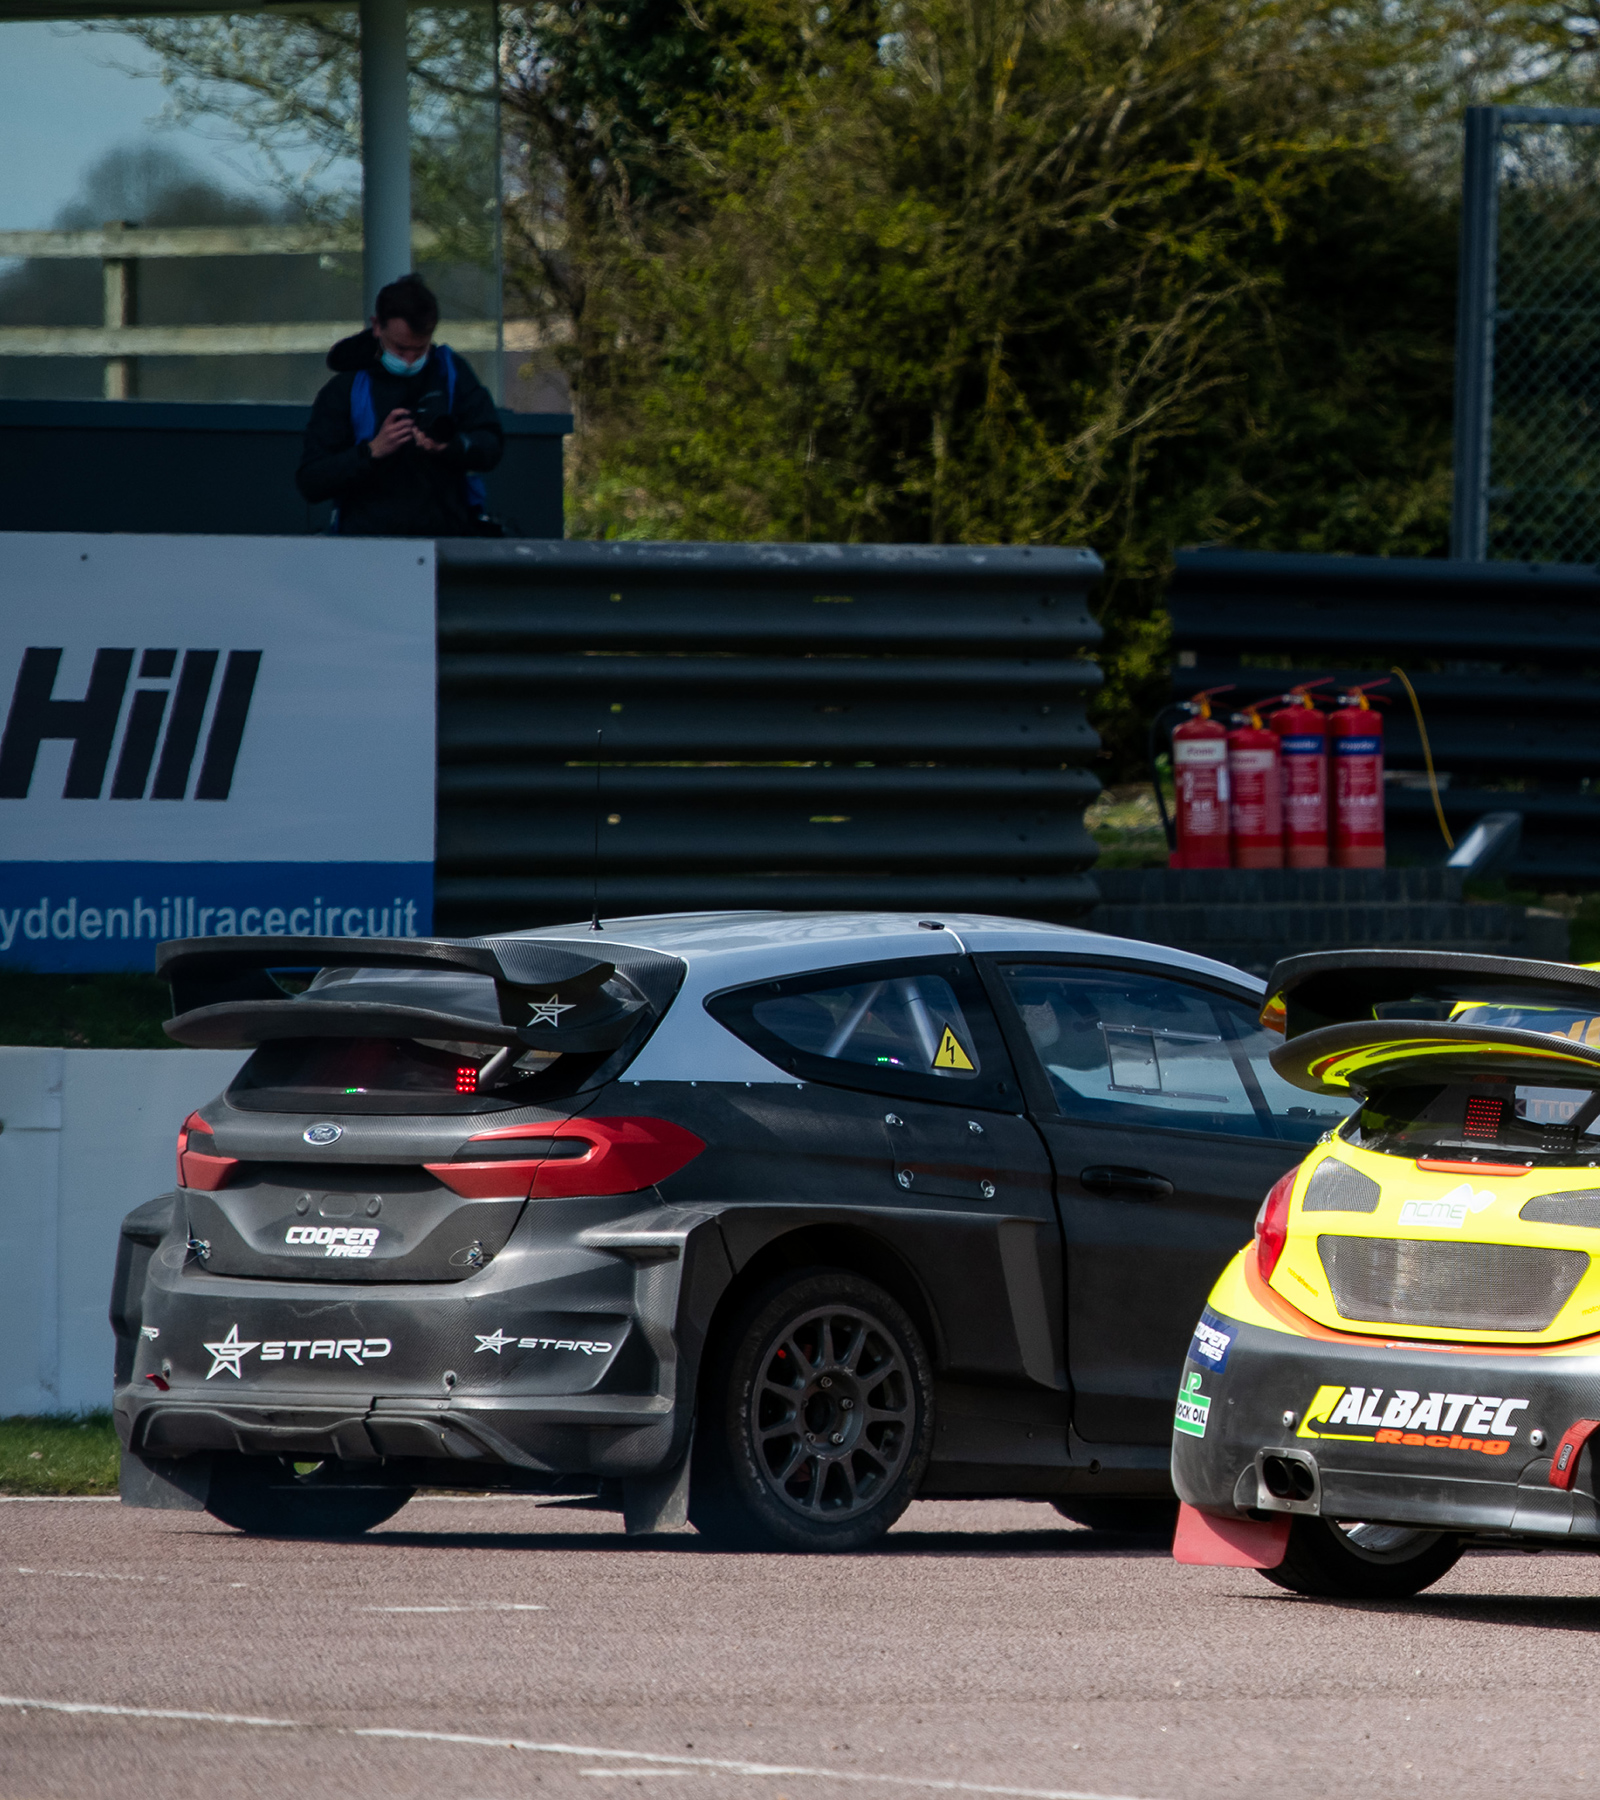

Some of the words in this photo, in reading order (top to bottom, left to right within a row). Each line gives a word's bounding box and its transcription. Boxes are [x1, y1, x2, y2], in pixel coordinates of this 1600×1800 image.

[0, 647, 263, 801] Hill
[285, 1226, 381, 1246] COOPER
[324, 1244, 375, 1258] TIRES
[260, 1338, 393, 1366] STARD
[517, 1337, 613, 1356] STARD
[1193, 1407, 1206, 1424] OIL
[1329, 1386, 1530, 1437] ALBATEC
[1375, 1428, 1511, 1456] Racing
